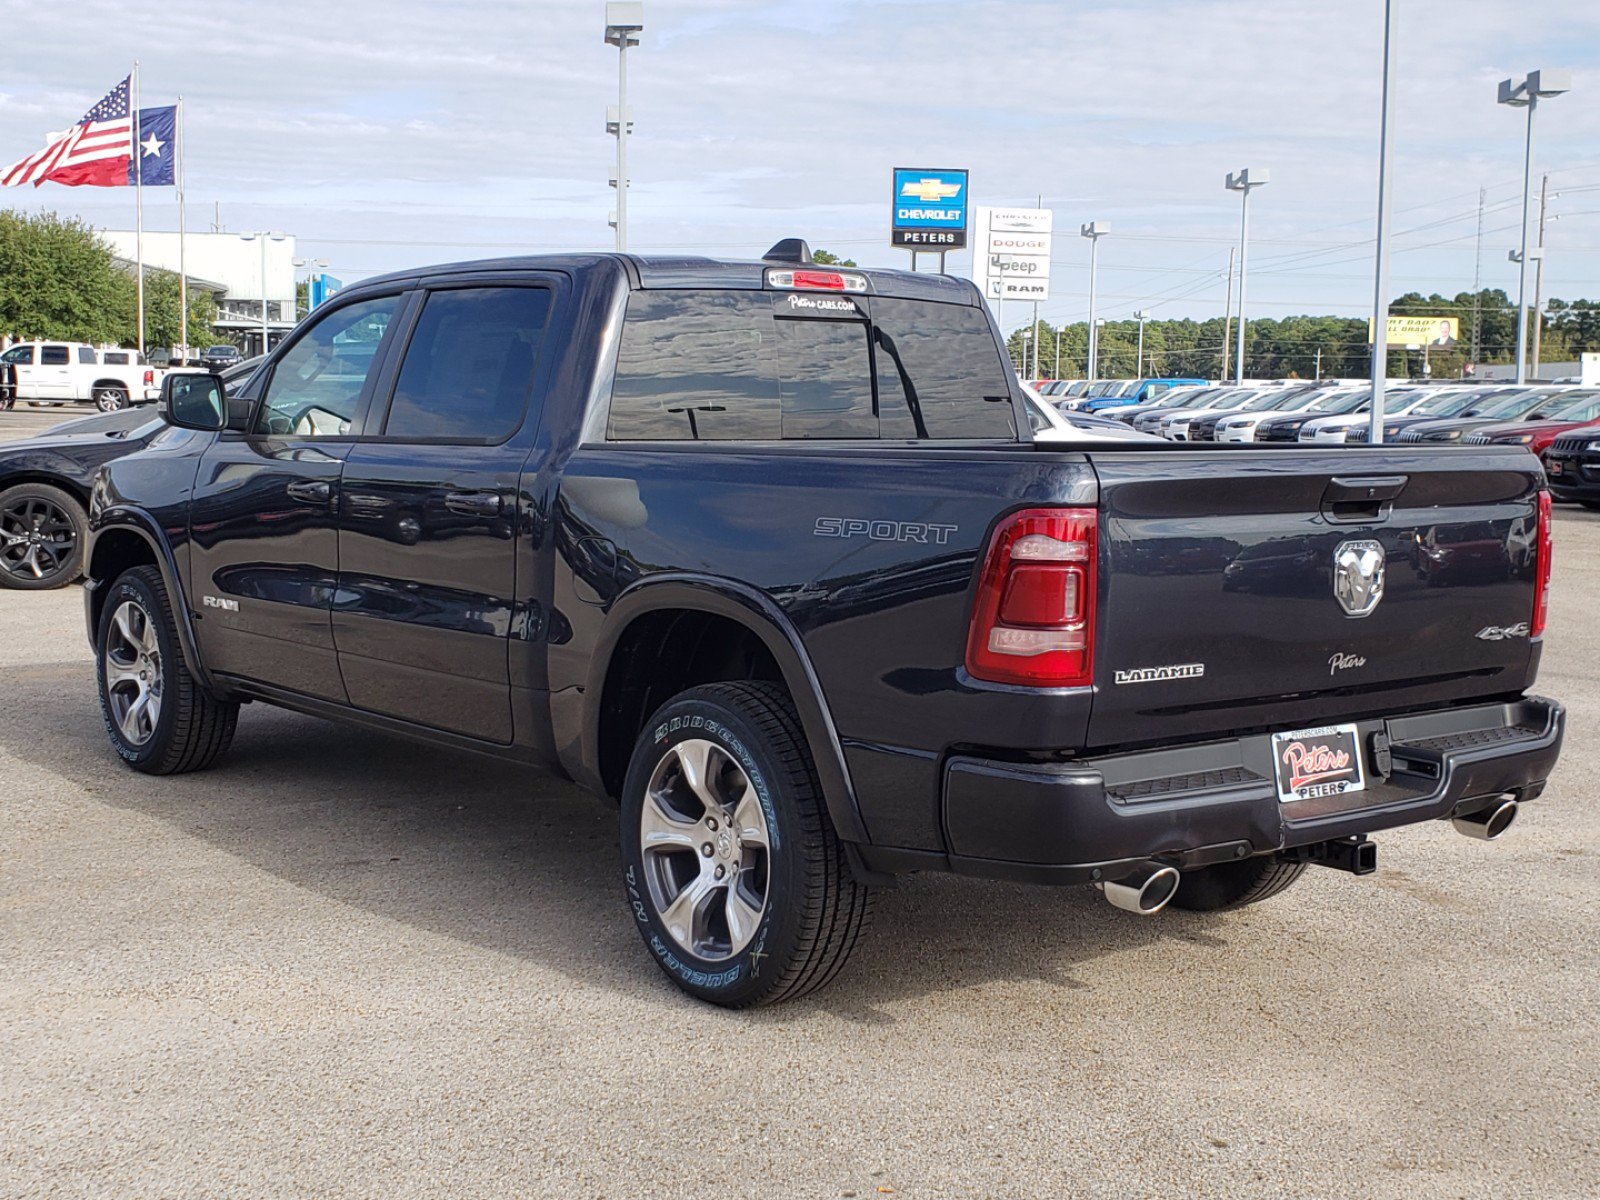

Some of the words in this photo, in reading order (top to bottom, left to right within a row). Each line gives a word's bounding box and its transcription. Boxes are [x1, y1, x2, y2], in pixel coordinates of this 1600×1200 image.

[898, 209, 961, 221] CHEVROLET
[904, 233, 955, 243] PETERS
[993, 240, 1047, 248] DODGE
[1007, 285, 1045, 293] RAM
[816, 300, 856, 311] CARS.COM
[813, 516, 958, 545] SPORT
[203, 595, 240, 613] RAM
[1328, 652, 1366, 676] Peters
[1115, 663, 1205, 684] LARAMIE
[1282, 741, 1350, 778] Peters
[1297, 781, 1348, 799] PETERS
